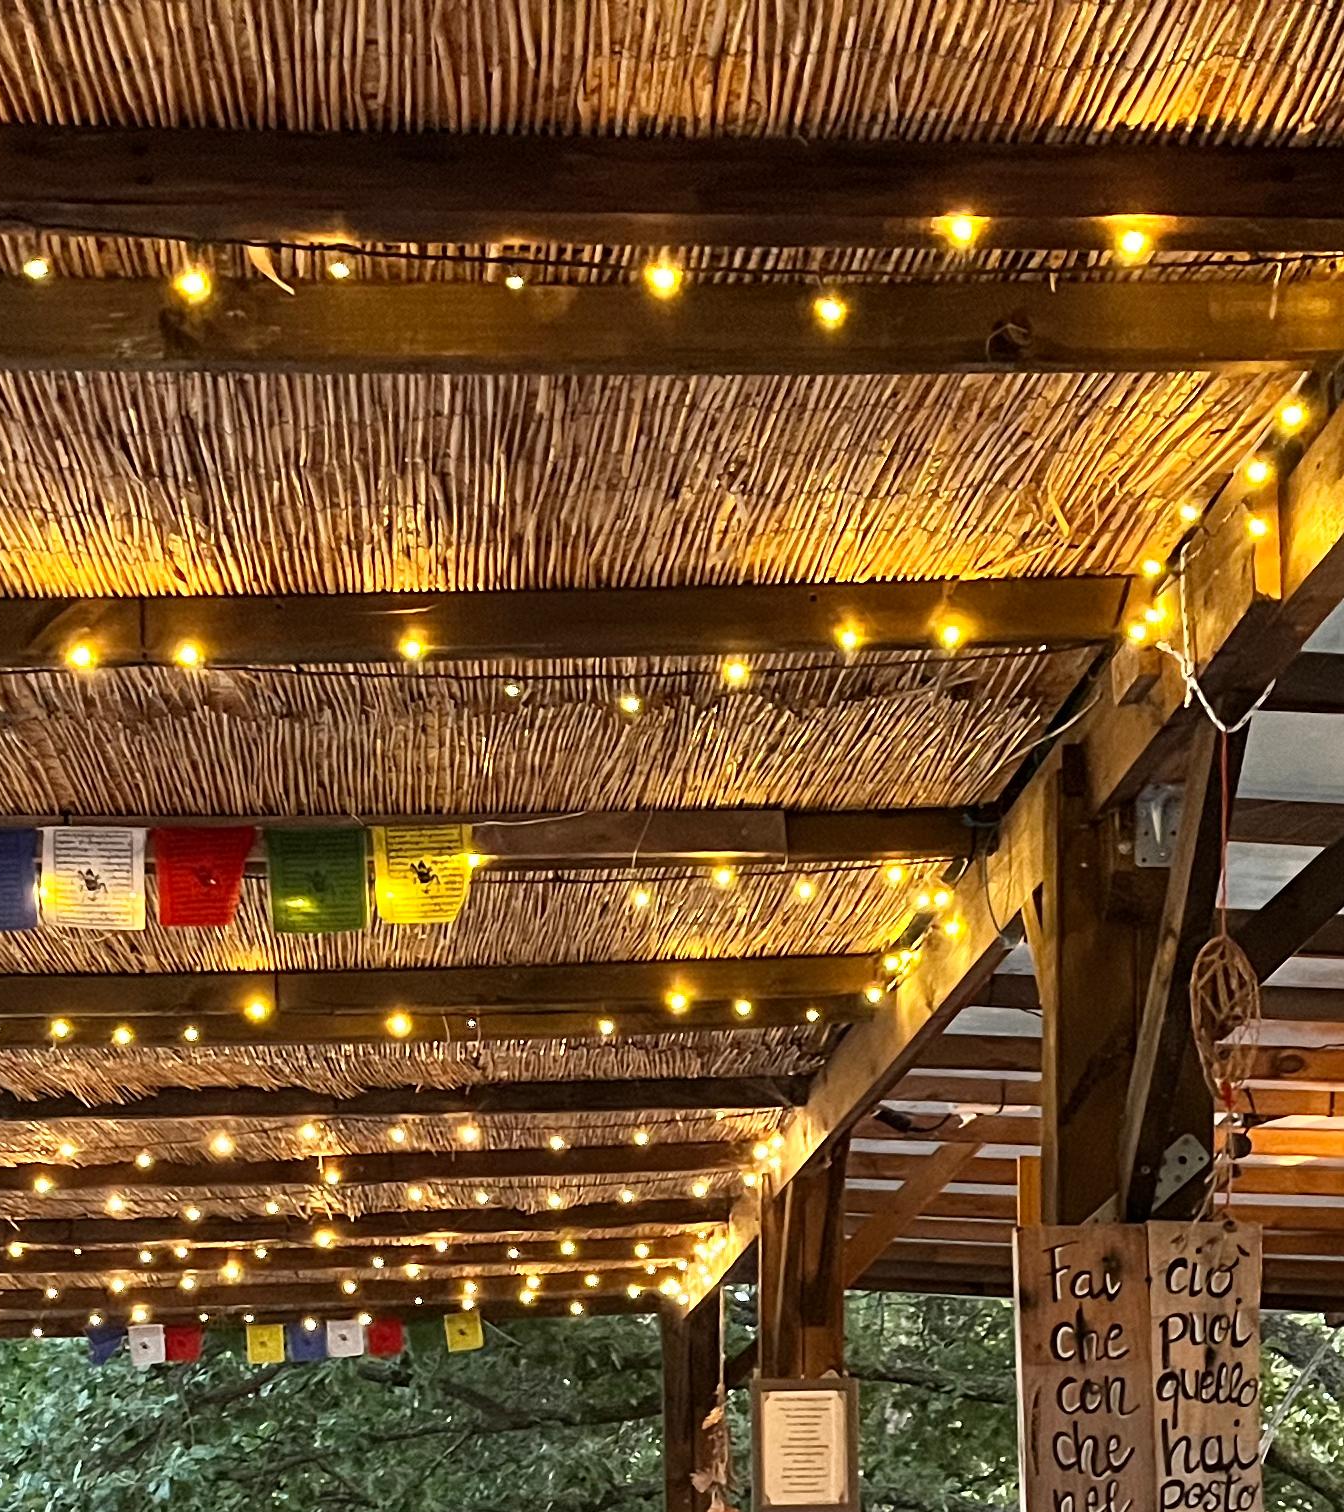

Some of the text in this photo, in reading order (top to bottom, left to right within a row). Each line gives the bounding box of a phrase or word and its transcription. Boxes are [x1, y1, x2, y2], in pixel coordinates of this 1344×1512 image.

[1043, 1241, 1250, 1302] Fai ciò
[1050, 1298, 1254, 1370] che puoi
[1056, 1361, 1259, 1429] con quello
[1052, 1418, 1260, 1479] che hai
